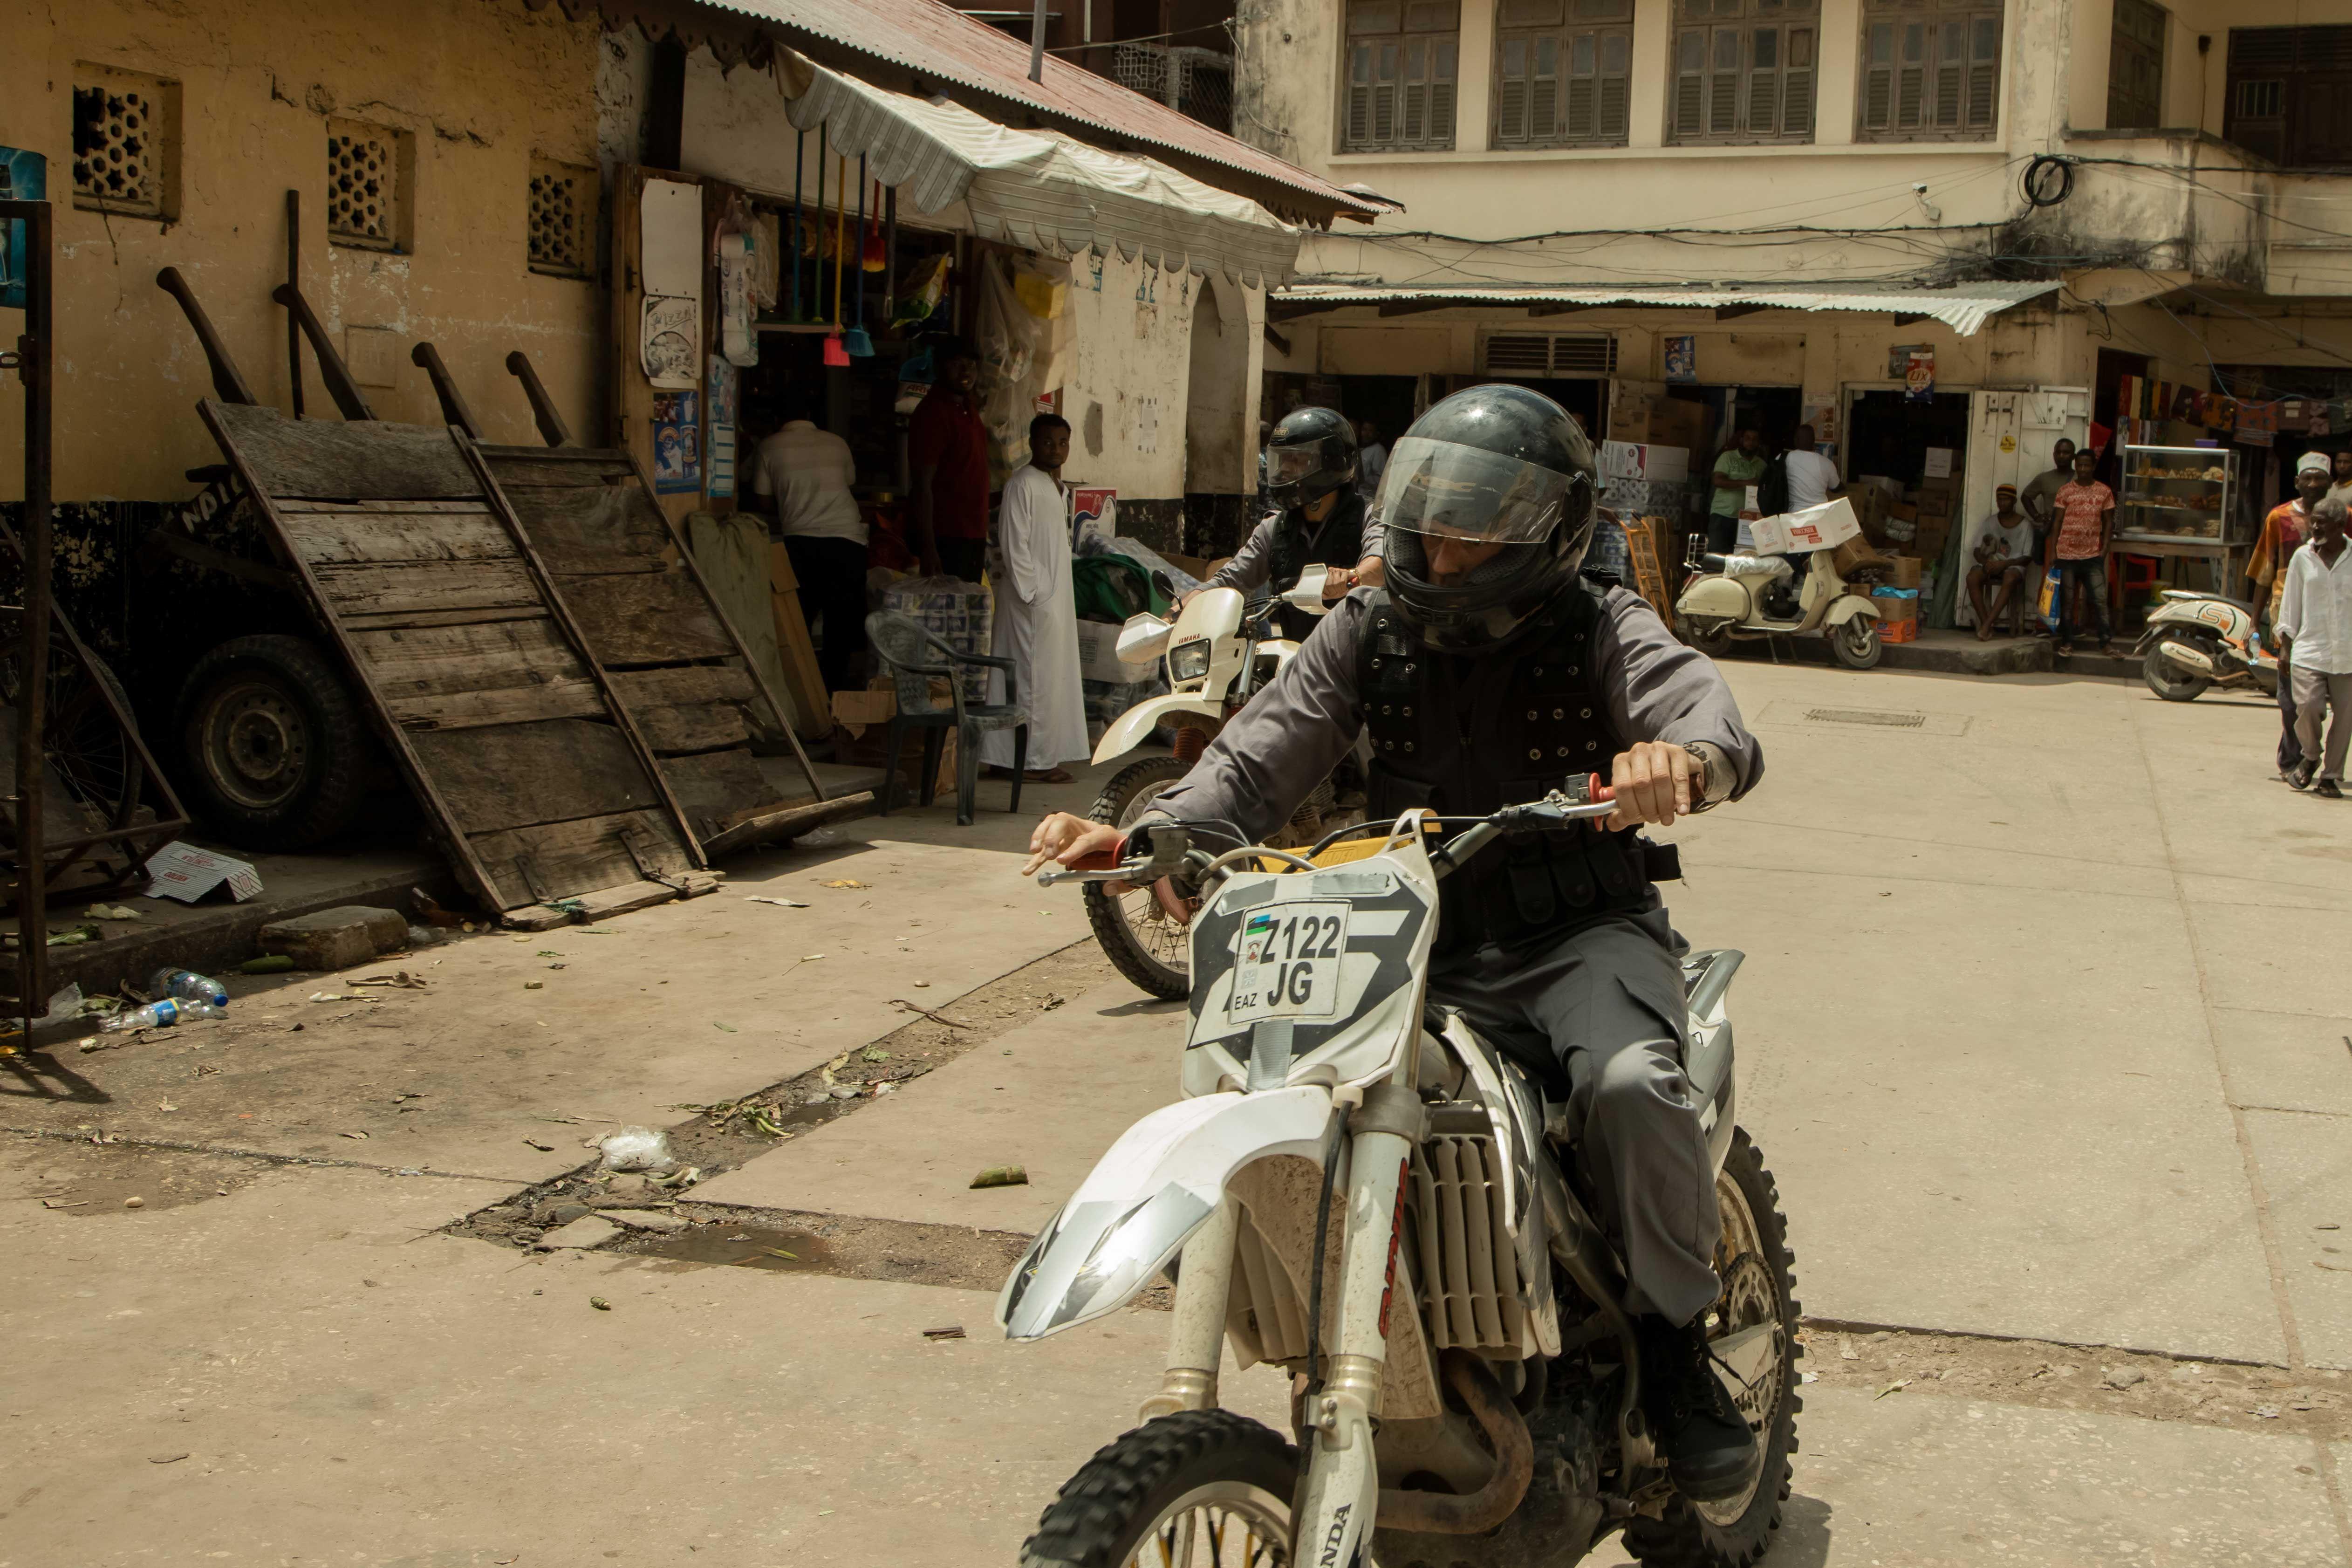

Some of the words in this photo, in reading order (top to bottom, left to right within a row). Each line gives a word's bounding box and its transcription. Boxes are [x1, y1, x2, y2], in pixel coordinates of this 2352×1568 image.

[1178, 633, 1201, 644] YAMAHA
[1259, 915, 1341, 965] Z122
[1267, 960, 1313, 1007] JG
[1234, 992, 1258, 1010] EAZ
